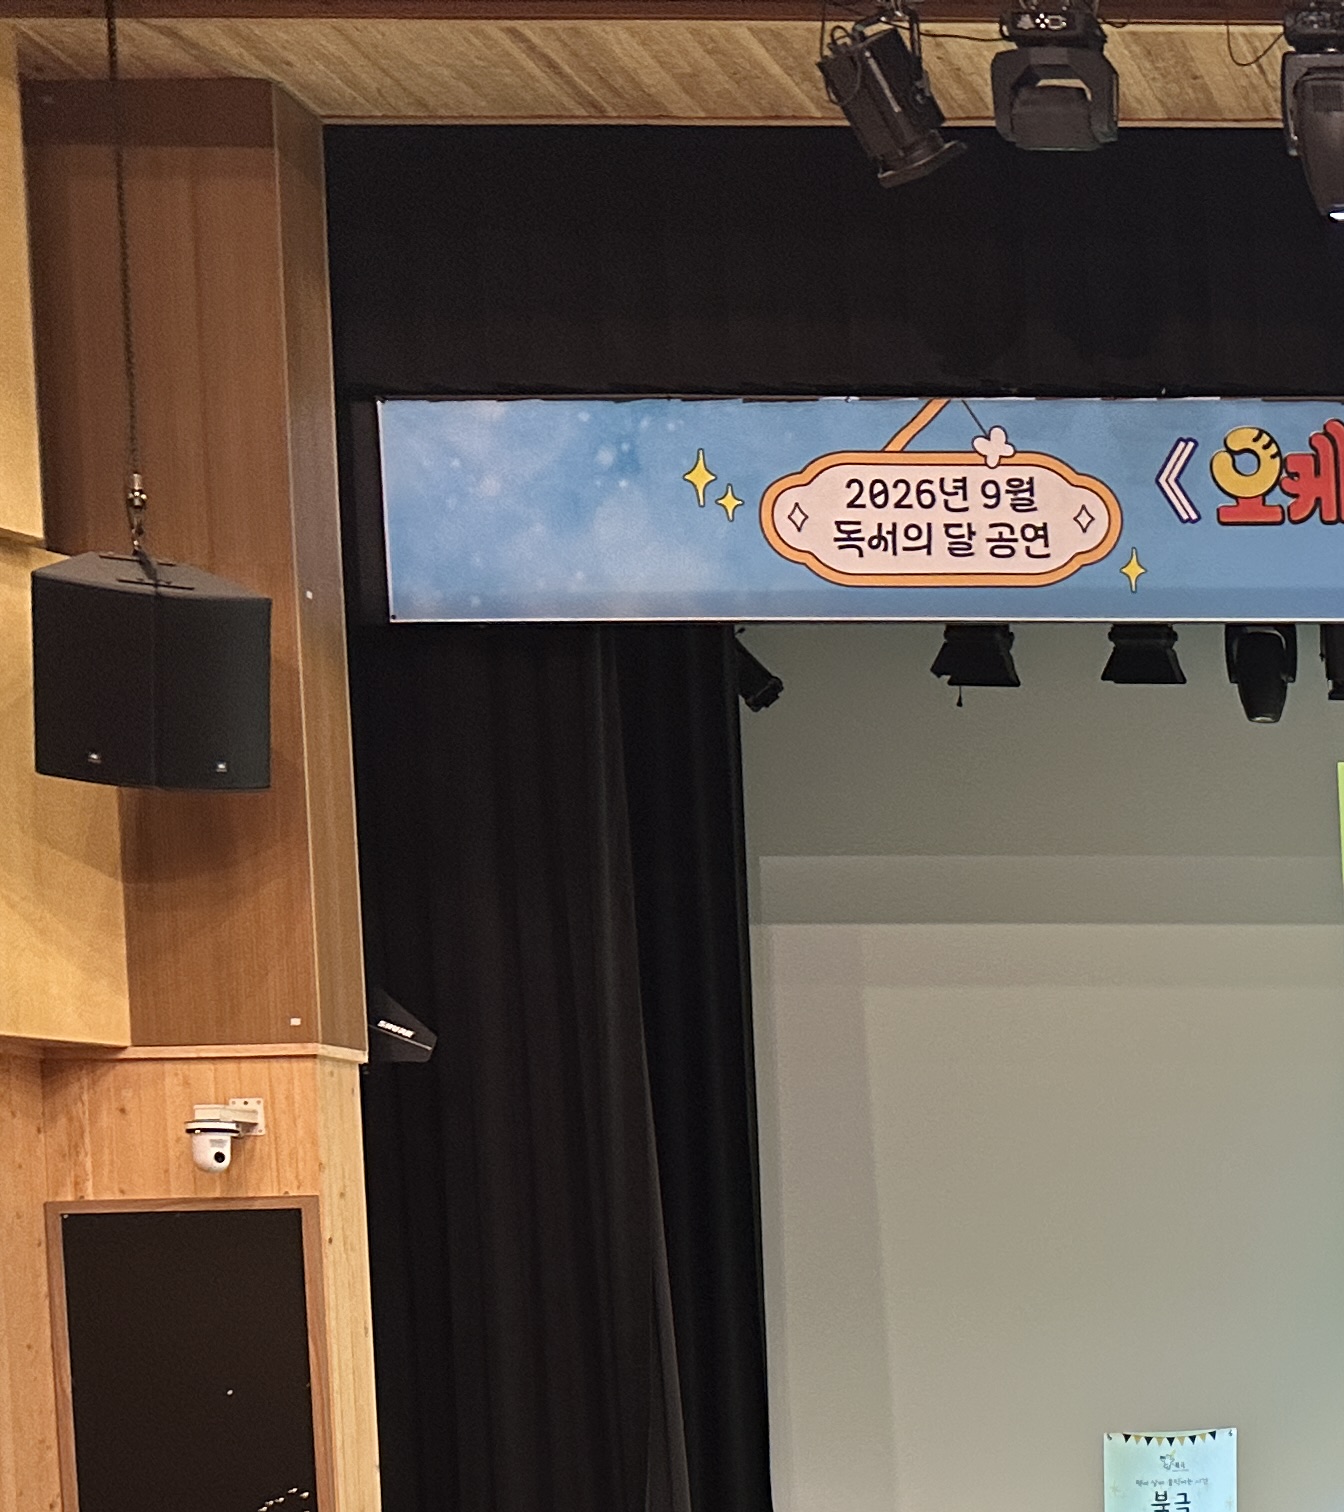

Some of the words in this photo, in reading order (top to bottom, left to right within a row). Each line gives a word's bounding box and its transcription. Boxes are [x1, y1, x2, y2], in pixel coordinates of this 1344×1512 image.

[845, 476, 969, 514] 2026년
[981, 476, 1038, 513] 9월
[832, 520, 934, 559] 독서의
[944, 522, 976, 559] 달
[986, 521, 1051, 559] 공연
